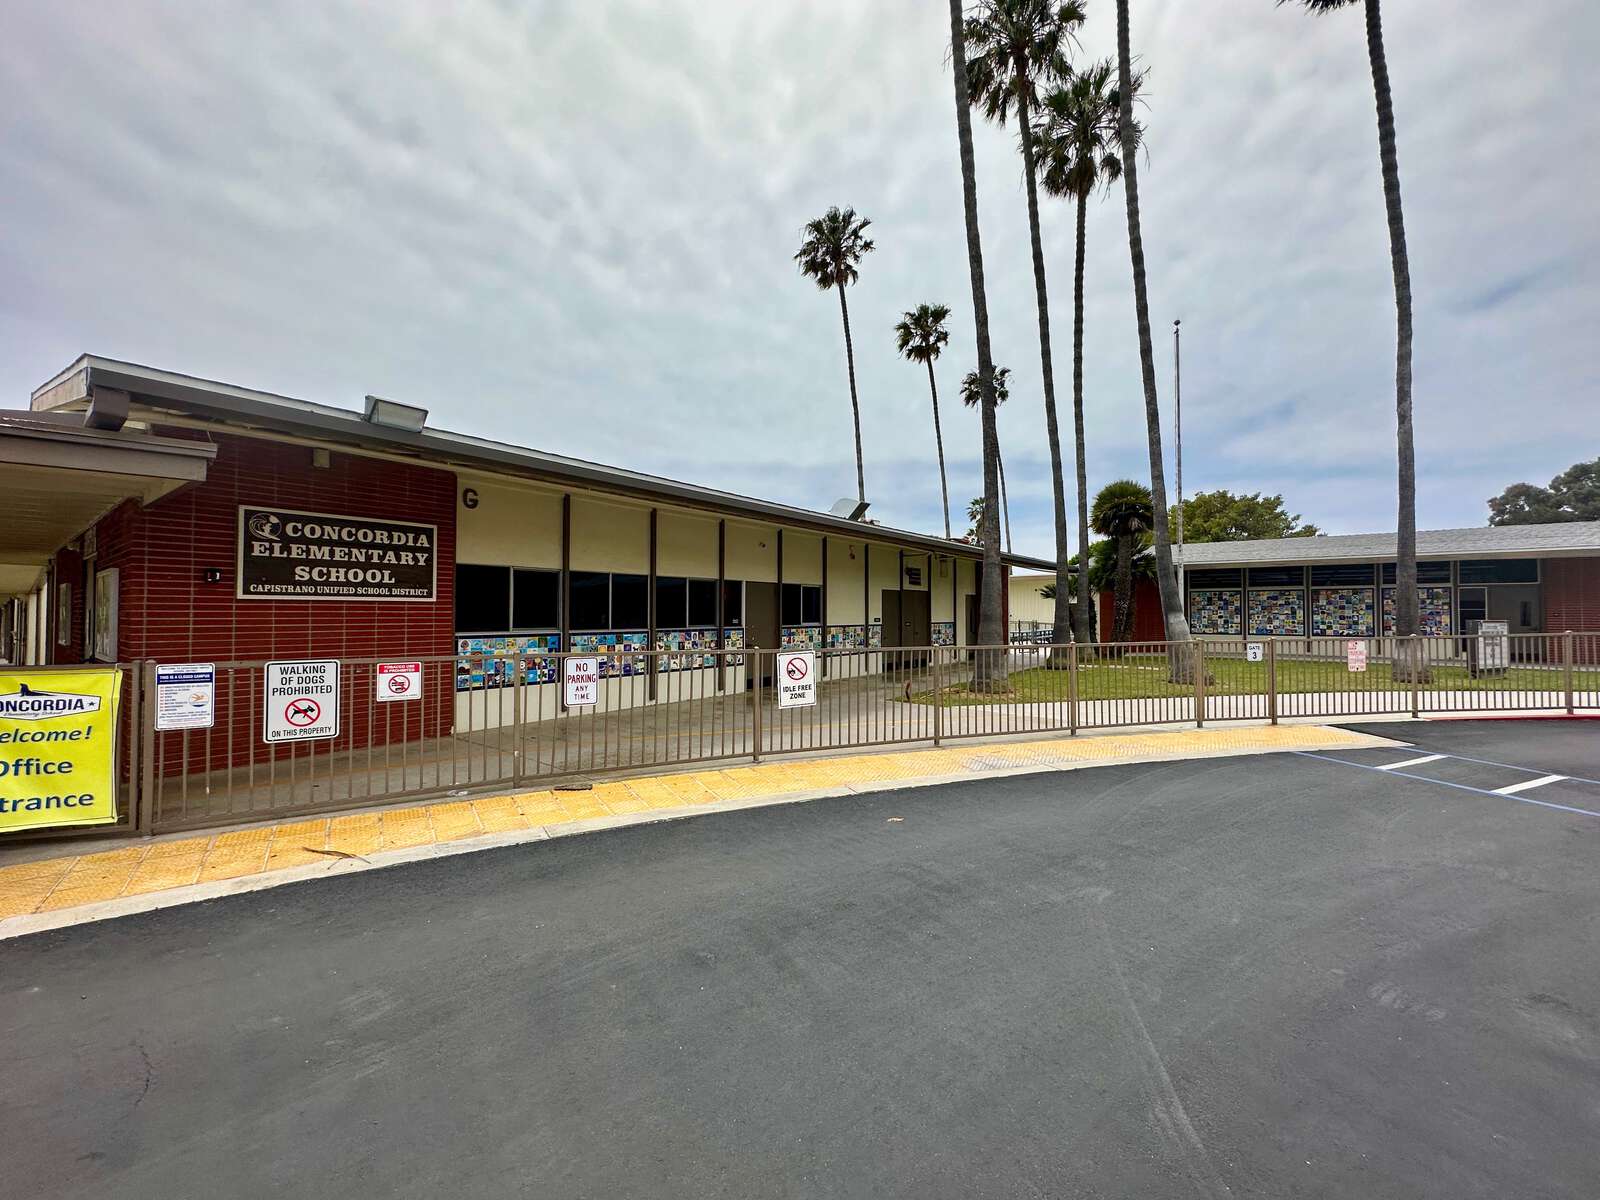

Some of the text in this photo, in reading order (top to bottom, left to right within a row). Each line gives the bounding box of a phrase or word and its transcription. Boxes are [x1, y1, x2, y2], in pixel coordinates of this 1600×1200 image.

[463, 488, 479, 509] G
[285, 522, 430, 547] CONCORDIA
[251, 541, 429, 566] ELEMENTARY
[294, 566, 395, 584] SCHOOL
[250, 584, 428, 596] CAPISTRANO UNIFIED SCHOOL DISTRICT
[1252, 651, 1258, 659] 3
[280, 665, 326, 675] WALKING
[575, 663, 588, 672] NO
[281, 675, 325, 685] OF DOGS
[567, 674, 596, 684] PARKING
[272, 685, 332, 696] PROHIBITED
[299, 726, 332, 735] PROPERTY
